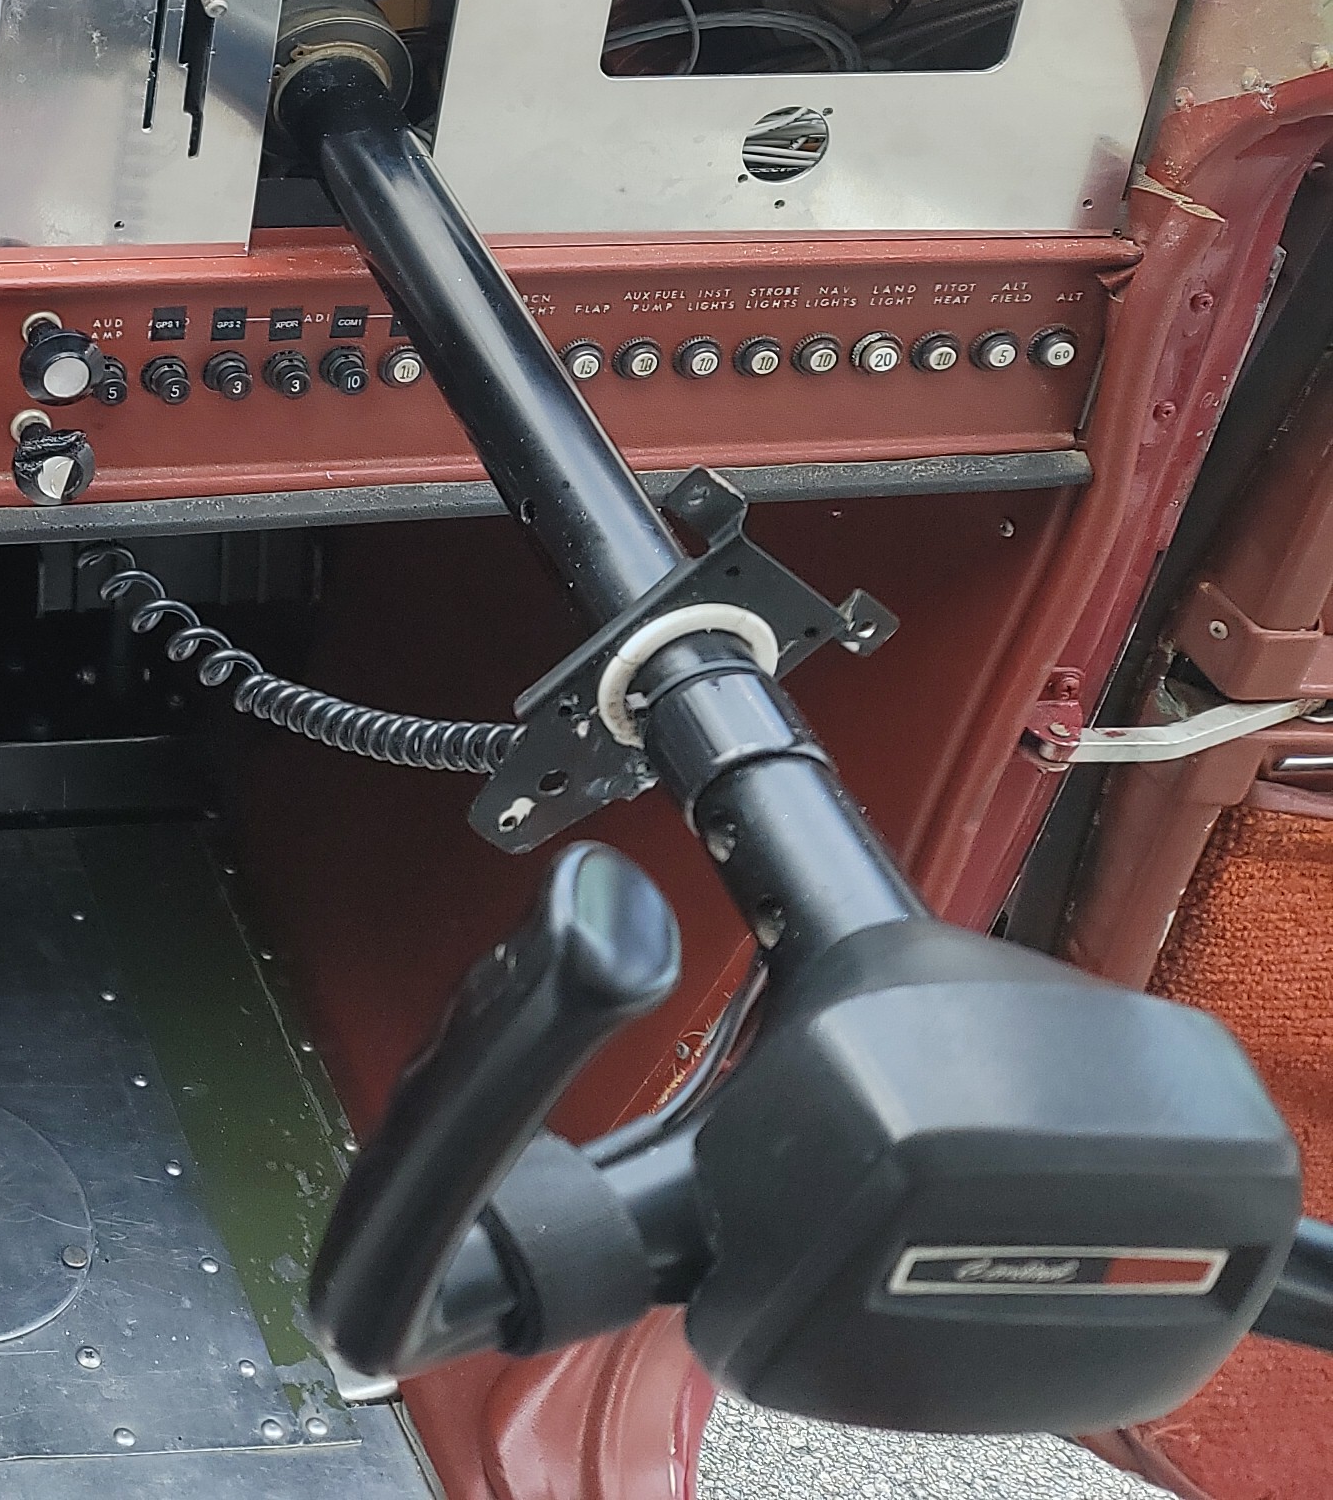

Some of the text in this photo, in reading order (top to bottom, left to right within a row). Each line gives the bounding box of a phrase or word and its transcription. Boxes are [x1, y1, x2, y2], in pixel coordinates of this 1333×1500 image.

[749, 286, 801, 297] STROBE
[819, 285, 851, 295] NAV
[872, 284, 917, 294] LAND
[934, 283, 977, 293] PITOT
[1002, 281, 1030, 291] ALT
[624, 290, 686, 301] AUX FUEL
[698, 288, 732, 298] INST
[989, 293, 1033, 303] FIELD
[1056, 292, 1084, 302] ALT
[745, 299, 798, 310] LIGHTS
[805, 298, 857, 308] LIGHTS
[869, 296, 915, 306] LIGHT
[933, 295, 971, 305] HEAT
[575, 304, 612, 314] FLAP
[632, 302, 673, 313] PUMP
[687, 301, 736, 312] LIGHTS
[92, 318, 124, 328] AUD
[303, 312, 331, 323] ADI
[816, 353, 833, 368] 10
[874, 352, 893, 368] 20
[934, 352, 952, 367] 10
[998, 350, 1009, 364] 5
[1054, 350, 1071, 361] 60
[579, 361, 594, 375] 15
[697, 357, 714, 371] 10
[757, 356, 774, 371] 10
[232, 381, 243, 394] 3
[290, 379, 301, 392] 3
[346, 376, 360, 389] 10
[107, 387, 118, 400] 5
[170, 385, 181, 398] 5
